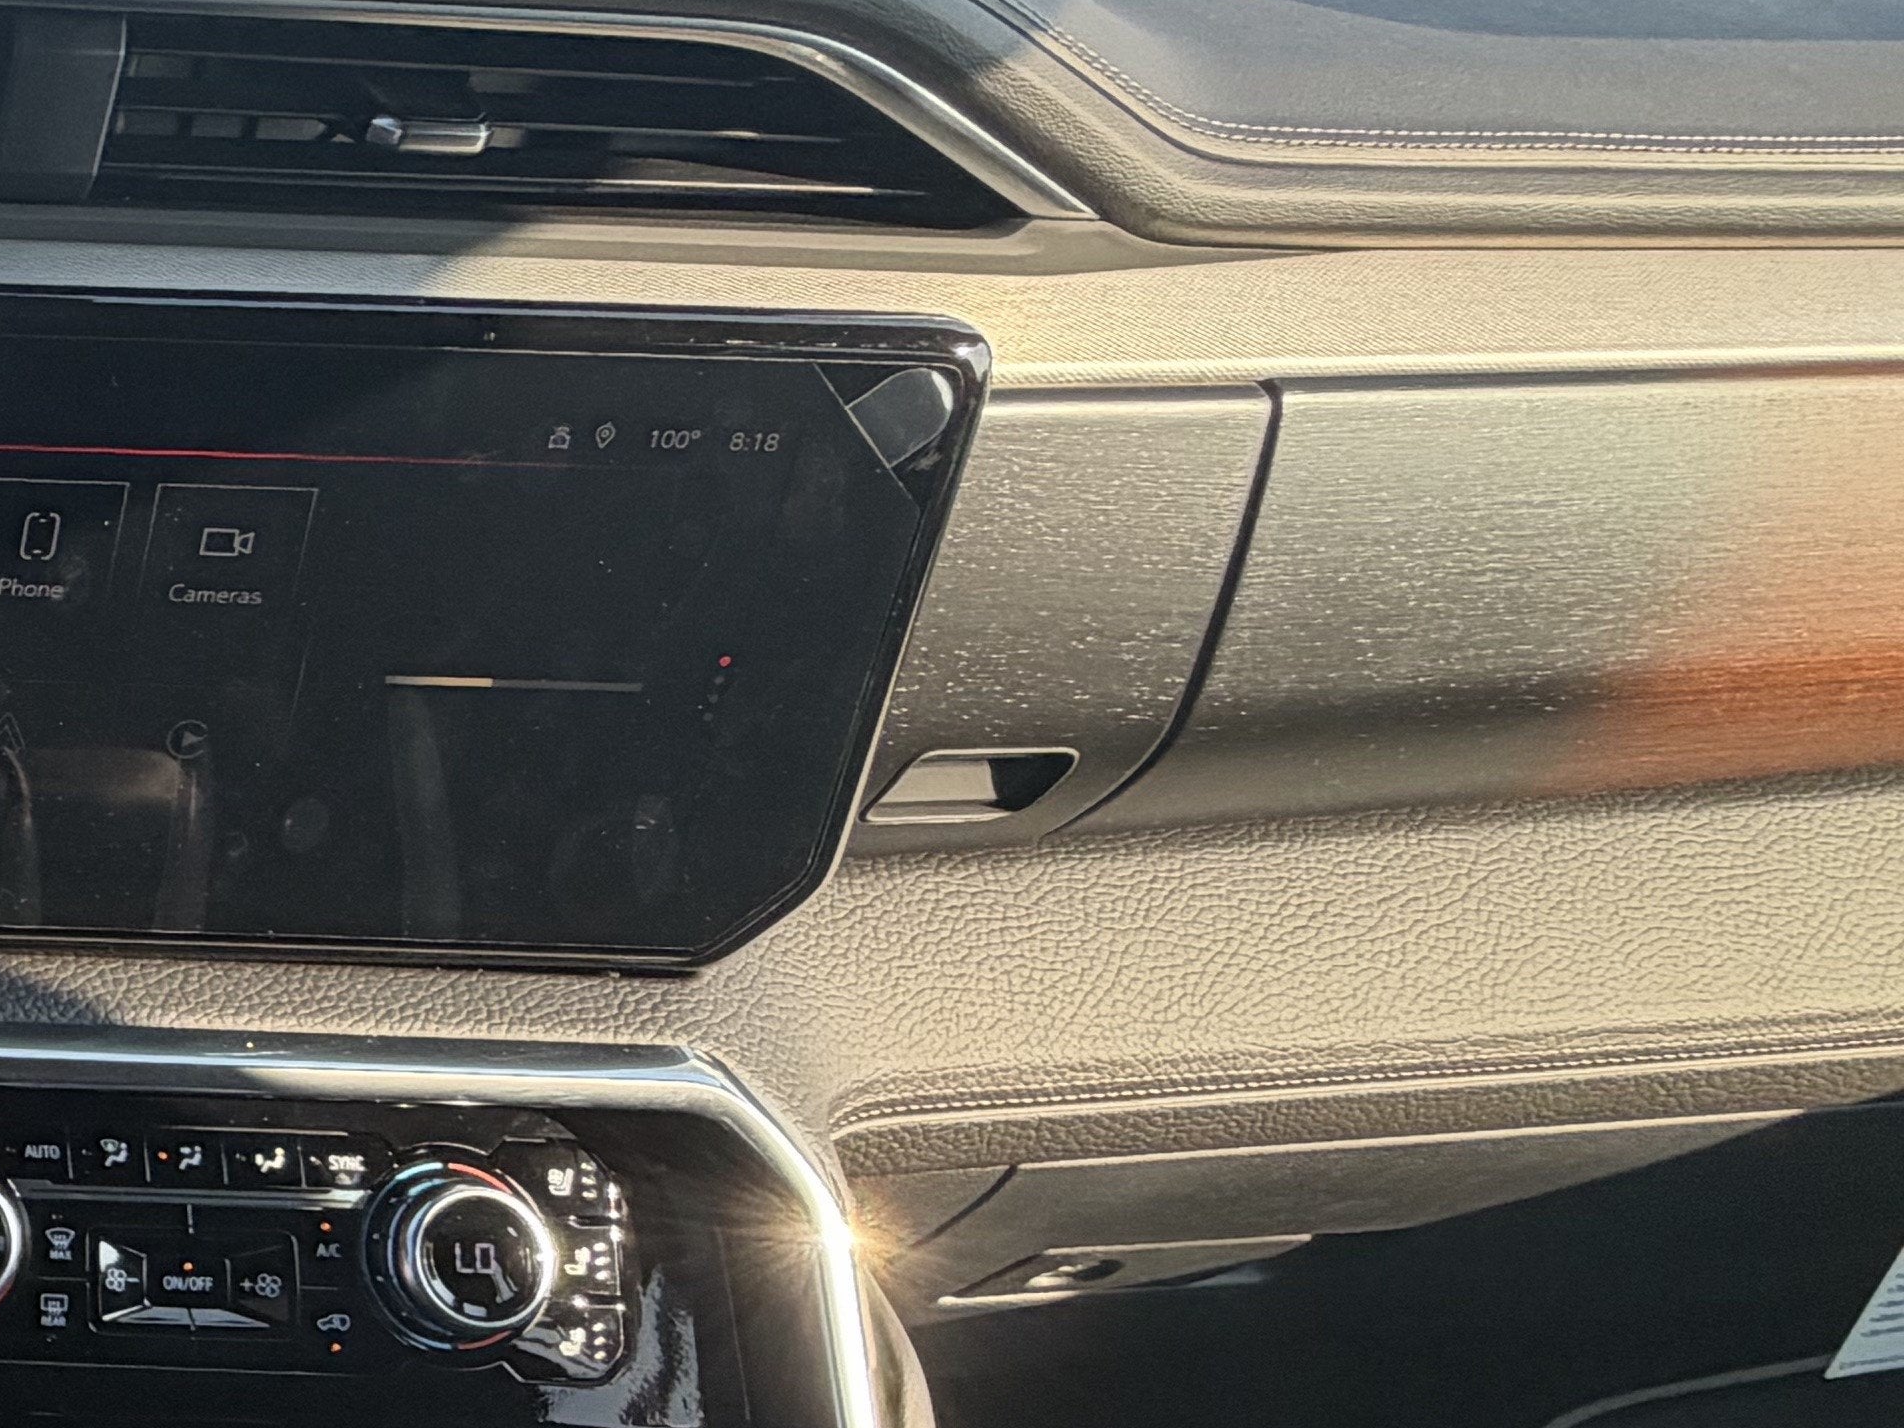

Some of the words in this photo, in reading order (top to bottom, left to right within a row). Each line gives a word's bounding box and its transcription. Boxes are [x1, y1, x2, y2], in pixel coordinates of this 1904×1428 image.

[729, 432, 780, 452] 8:18
[168, 584, 263, 606] Cameras
[24, 1144, 61, 1161] AUTO
[328, 1155, 365, 1173] SYNC
[48, 1246, 74, 1261] MAX
[315, 1241, 343, 1260] A/C
[162, 1274, 214, 1294] ON/OFF
